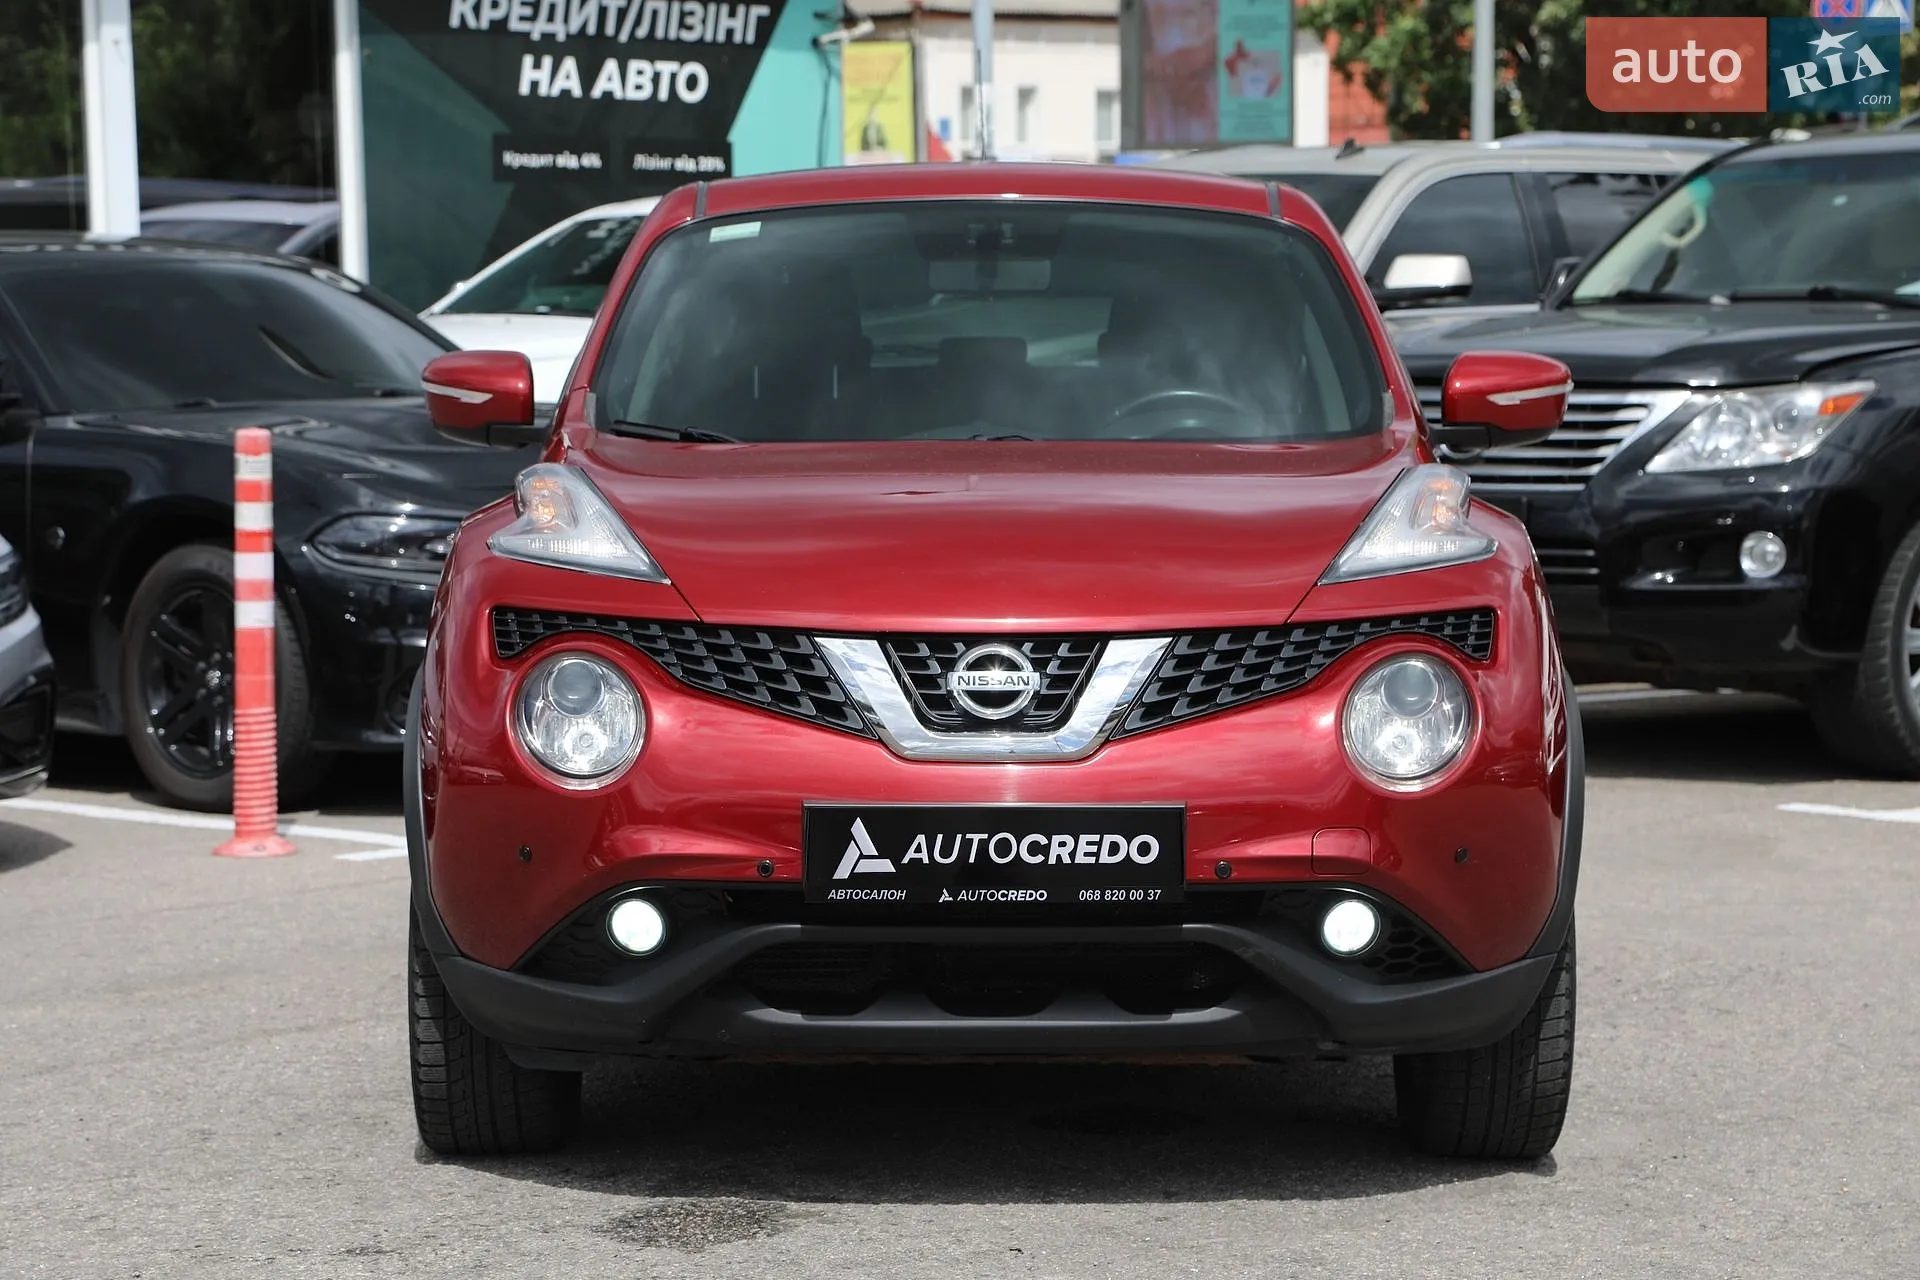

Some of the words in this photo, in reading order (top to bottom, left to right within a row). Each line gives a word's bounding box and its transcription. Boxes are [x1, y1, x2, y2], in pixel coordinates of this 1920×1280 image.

[448, 0, 770, 45] КРЕДИТ/ЛІЗІНГ
[518, 53, 583, 98] НА
[590, 57, 709, 104] АВТО
[957, 675, 1030, 686] NISSAN
[900, 832, 1160, 865] AUTOCREDO
[827, 889, 907, 900] АВТОСАЛОН
[957, 889, 1048, 901] AUTOCREDO
[1079, 889, 1101, 901] 068
[1104, 889, 1126, 901] 820
[1129, 889, 1144, 901] 00
[1147, 889, 1162, 901] 37
